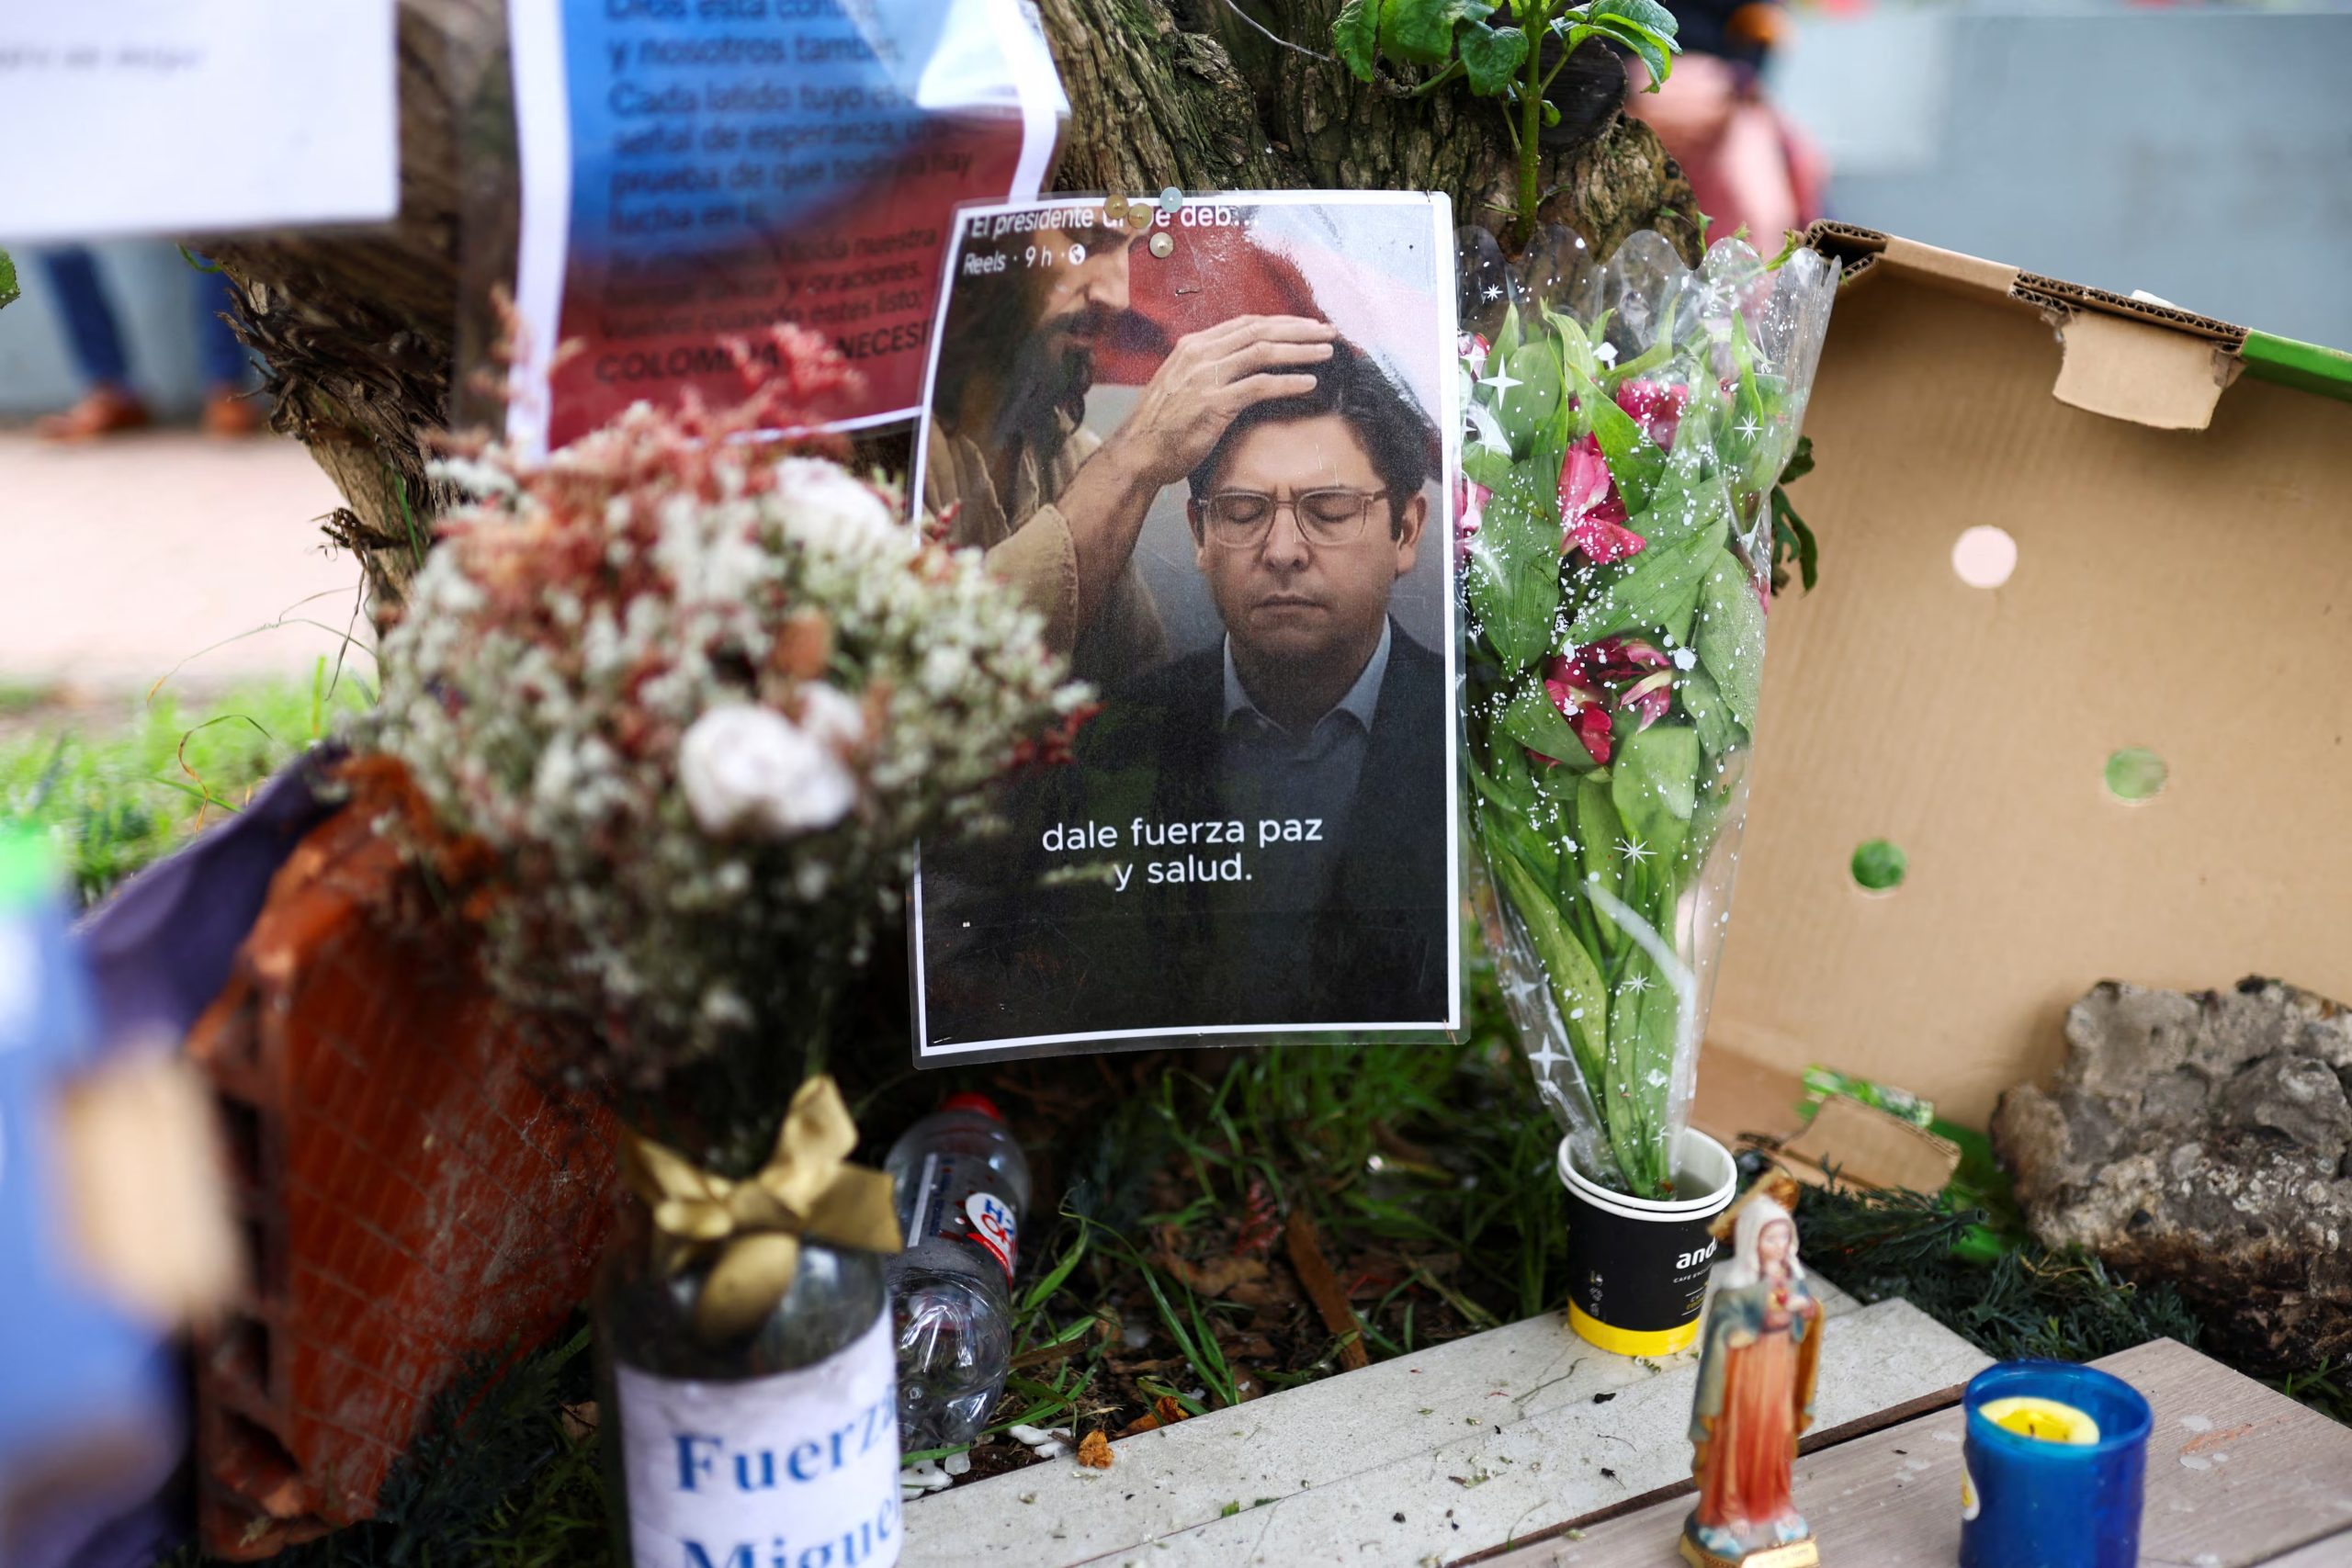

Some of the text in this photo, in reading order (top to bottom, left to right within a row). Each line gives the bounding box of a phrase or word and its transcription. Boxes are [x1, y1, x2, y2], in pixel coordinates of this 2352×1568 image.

[971, 214, 989, 238] El
[992, 208, 1094, 241] presidente
[964, 245, 1052, 275] Reels 9 h
[1042, 817, 1323, 852] dale fuerza paz
[1113, 852, 1252, 892] y salud.
[1675, 1235, 1718, 1269] and
